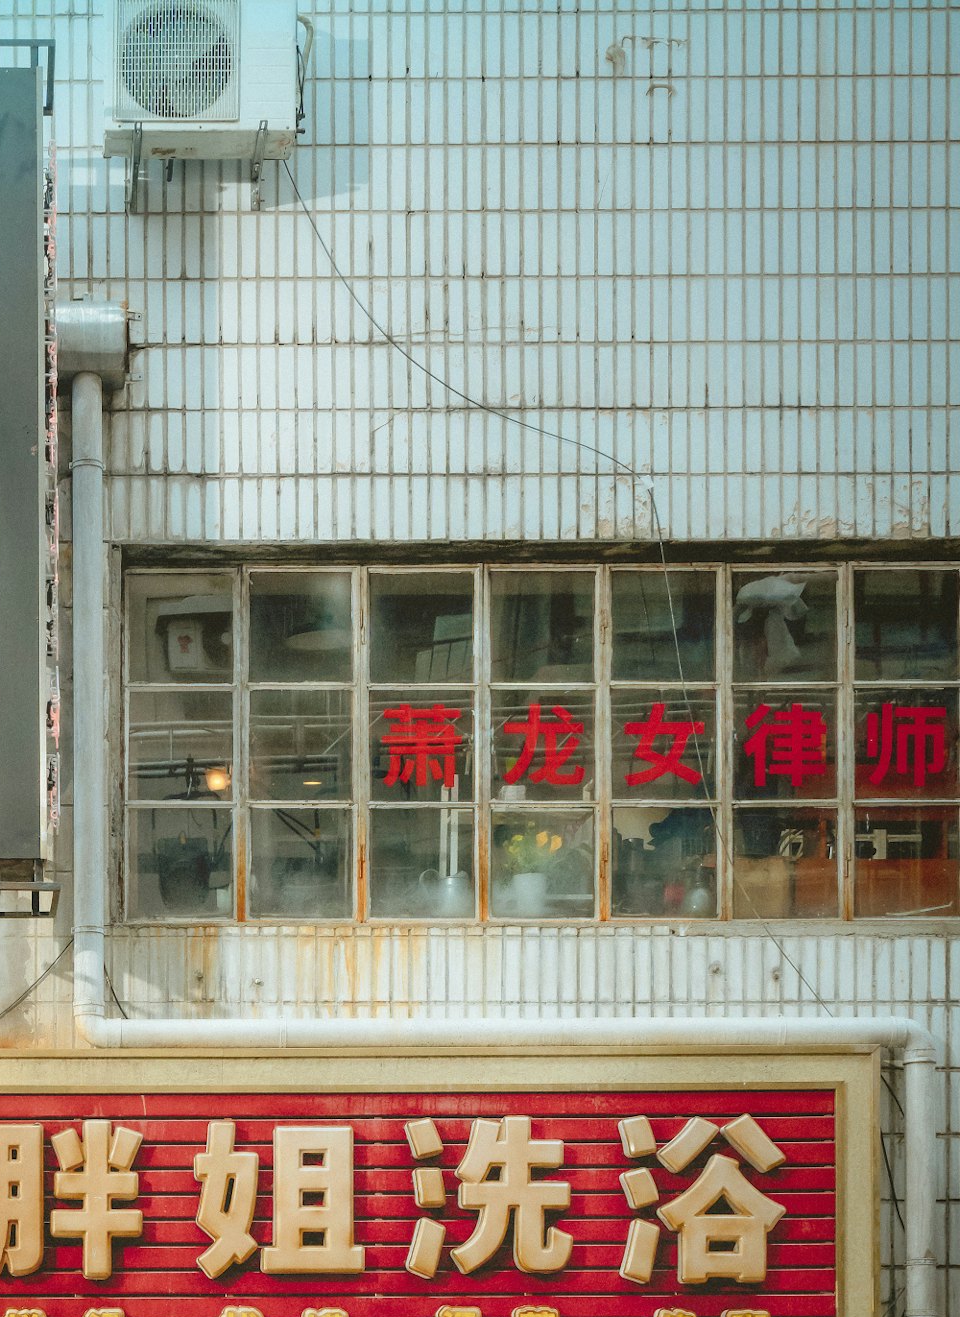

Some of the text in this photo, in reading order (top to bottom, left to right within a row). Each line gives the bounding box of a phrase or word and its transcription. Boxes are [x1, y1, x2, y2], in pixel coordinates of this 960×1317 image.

[382, 702, 948, 788] 萧龙女律师
